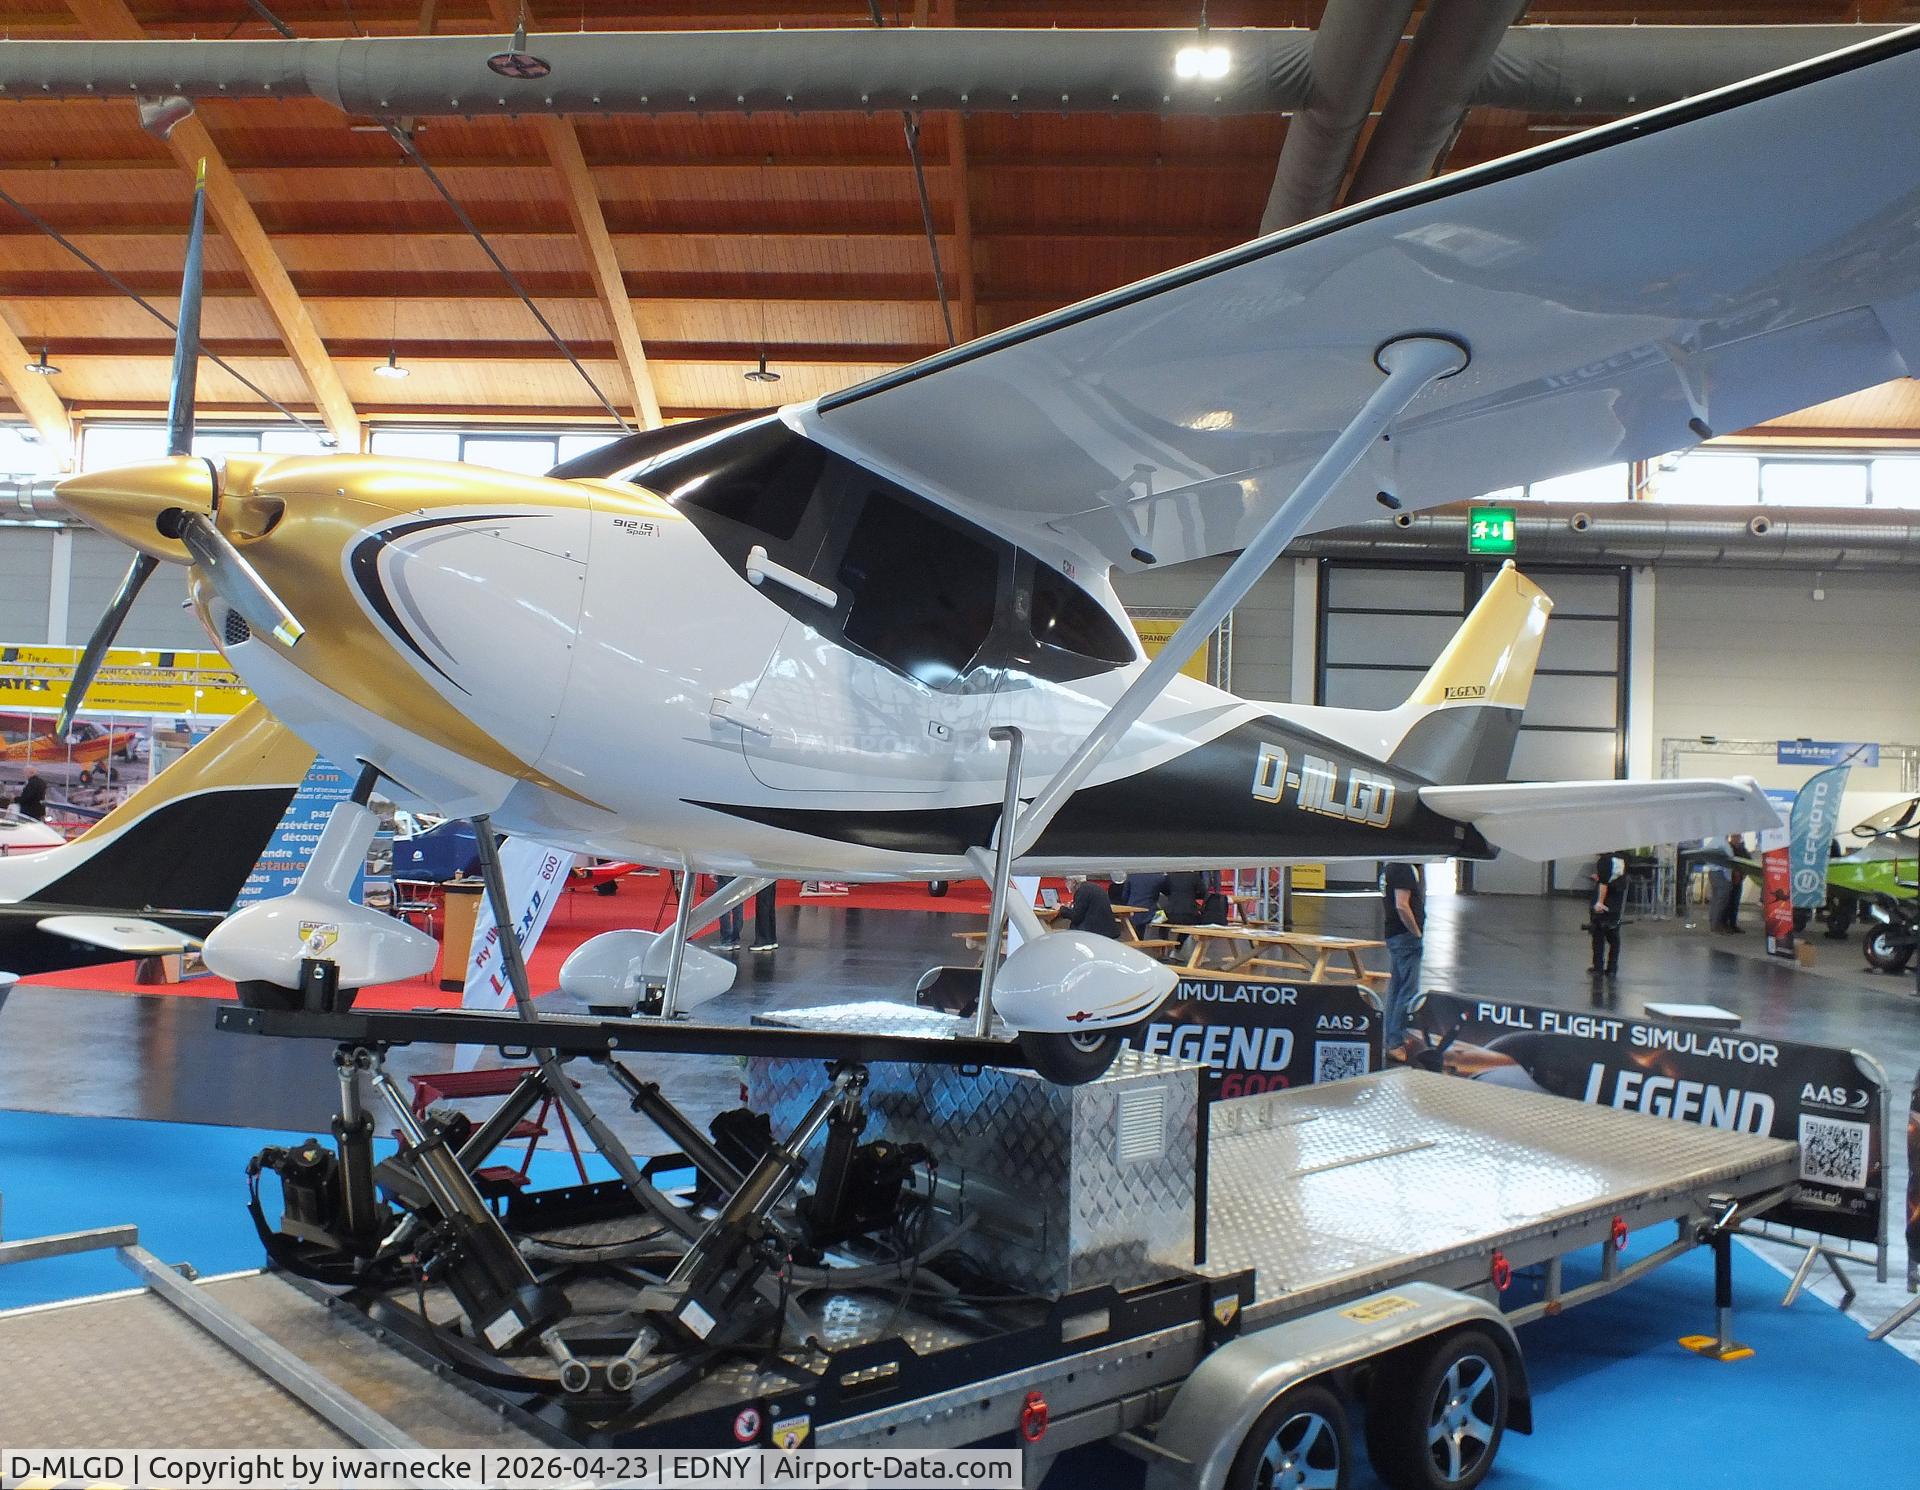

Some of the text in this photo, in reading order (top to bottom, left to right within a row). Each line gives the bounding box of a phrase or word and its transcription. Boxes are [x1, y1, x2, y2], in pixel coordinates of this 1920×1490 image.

[613, 519, 637, 528] 912
[1251, 741, 1396, 829] D-MLGD
[1804, 781, 1829, 865] CFMOTO
[253, 860, 308, 871] estaure
[541, 855, 558, 881] 600
[475, 946, 491, 969] Fly
[1178, 984, 1298, 1006] IMULATOR
[1316, 1015, 1353, 1030] AAS
[1477, 1002, 1779, 1068] FULL FLIGHT SIMULATOR
[1121, 1022, 1295, 1072] EGEND
[1584, 1062, 1776, 1139] LEGEND
[1801, 1082, 1847, 1106] AAS
